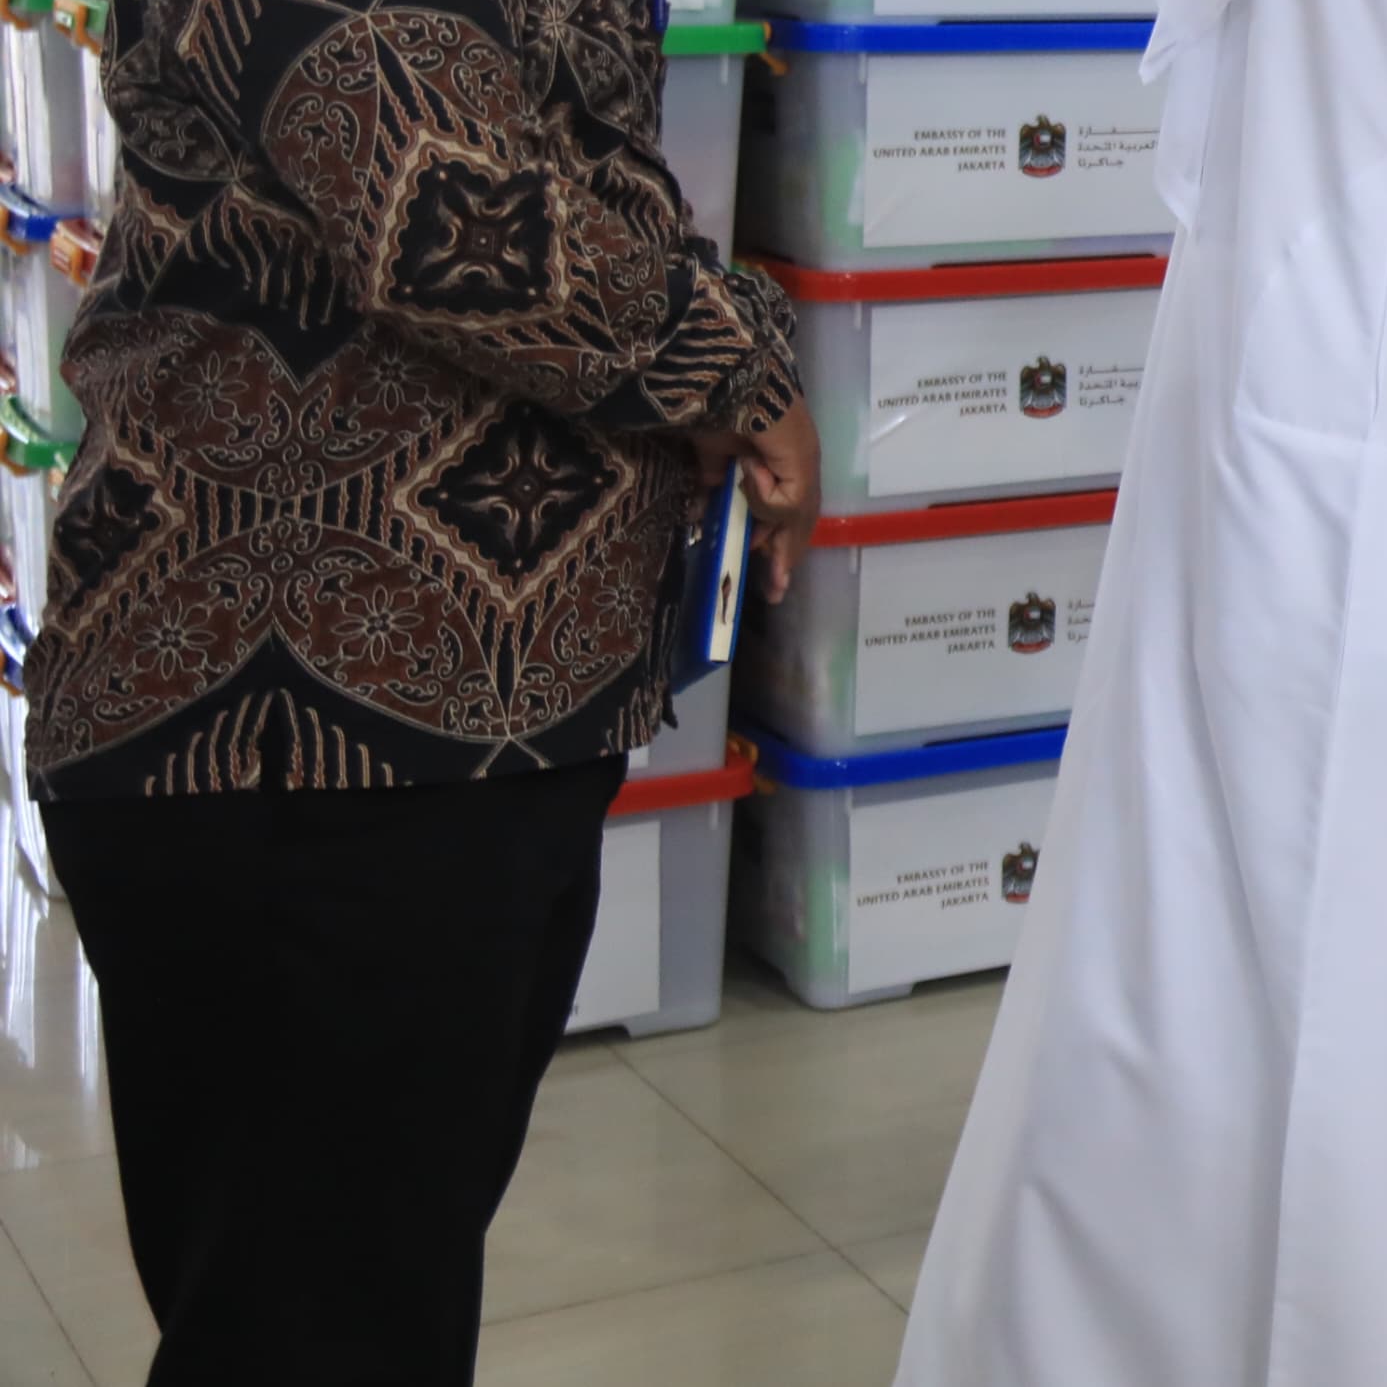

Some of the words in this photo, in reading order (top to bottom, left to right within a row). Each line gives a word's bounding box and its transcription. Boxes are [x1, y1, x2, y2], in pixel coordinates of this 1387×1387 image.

[913, 129, 965, 141] EMBASSY
[967, 129, 982, 140] OF
[986, 128, 1006, 139] THE
[873, 147, 917, 159] UNITED
[919, 146, 950, 157] ARAB
[952, 144, 1006, 156] EMIRATES
[957, 160, 1006, 172] JAKARTA
[917, 375, 966, 389] EMBASSY
[968, 373, 983, 384] OF
[986, 371, 1007, 383] THE
[877, 395, 920, 409] UNITED
[921, 391, 952, 404] ARAB
[954, 387, 1008, 402] EMIRATES
[959, 402, 1007, 417] JAKARTA
[904, 614, 955, 628] EMBASSY
[957, 611, 973, 622] OF
[975, 608, 996, 619] THE
[864, 634, 908, 647] UNITED
[910, 629, 941, 642] ARAB
[943, 623, 996, 639] EMIRATES
[947, 639, 995, 655] JAKARTA
[896, 868, 947, 884] EMBASSY
[950, 864, 965, 876] OF
[968, 860, 989, 873] THE
[856, 891, 900, 907] UNITED
[903, 885, 934, 900] ARAB
[936, 875, 990, 894] EMIRATES
[941, 891, 989, 910] JAKARTA
